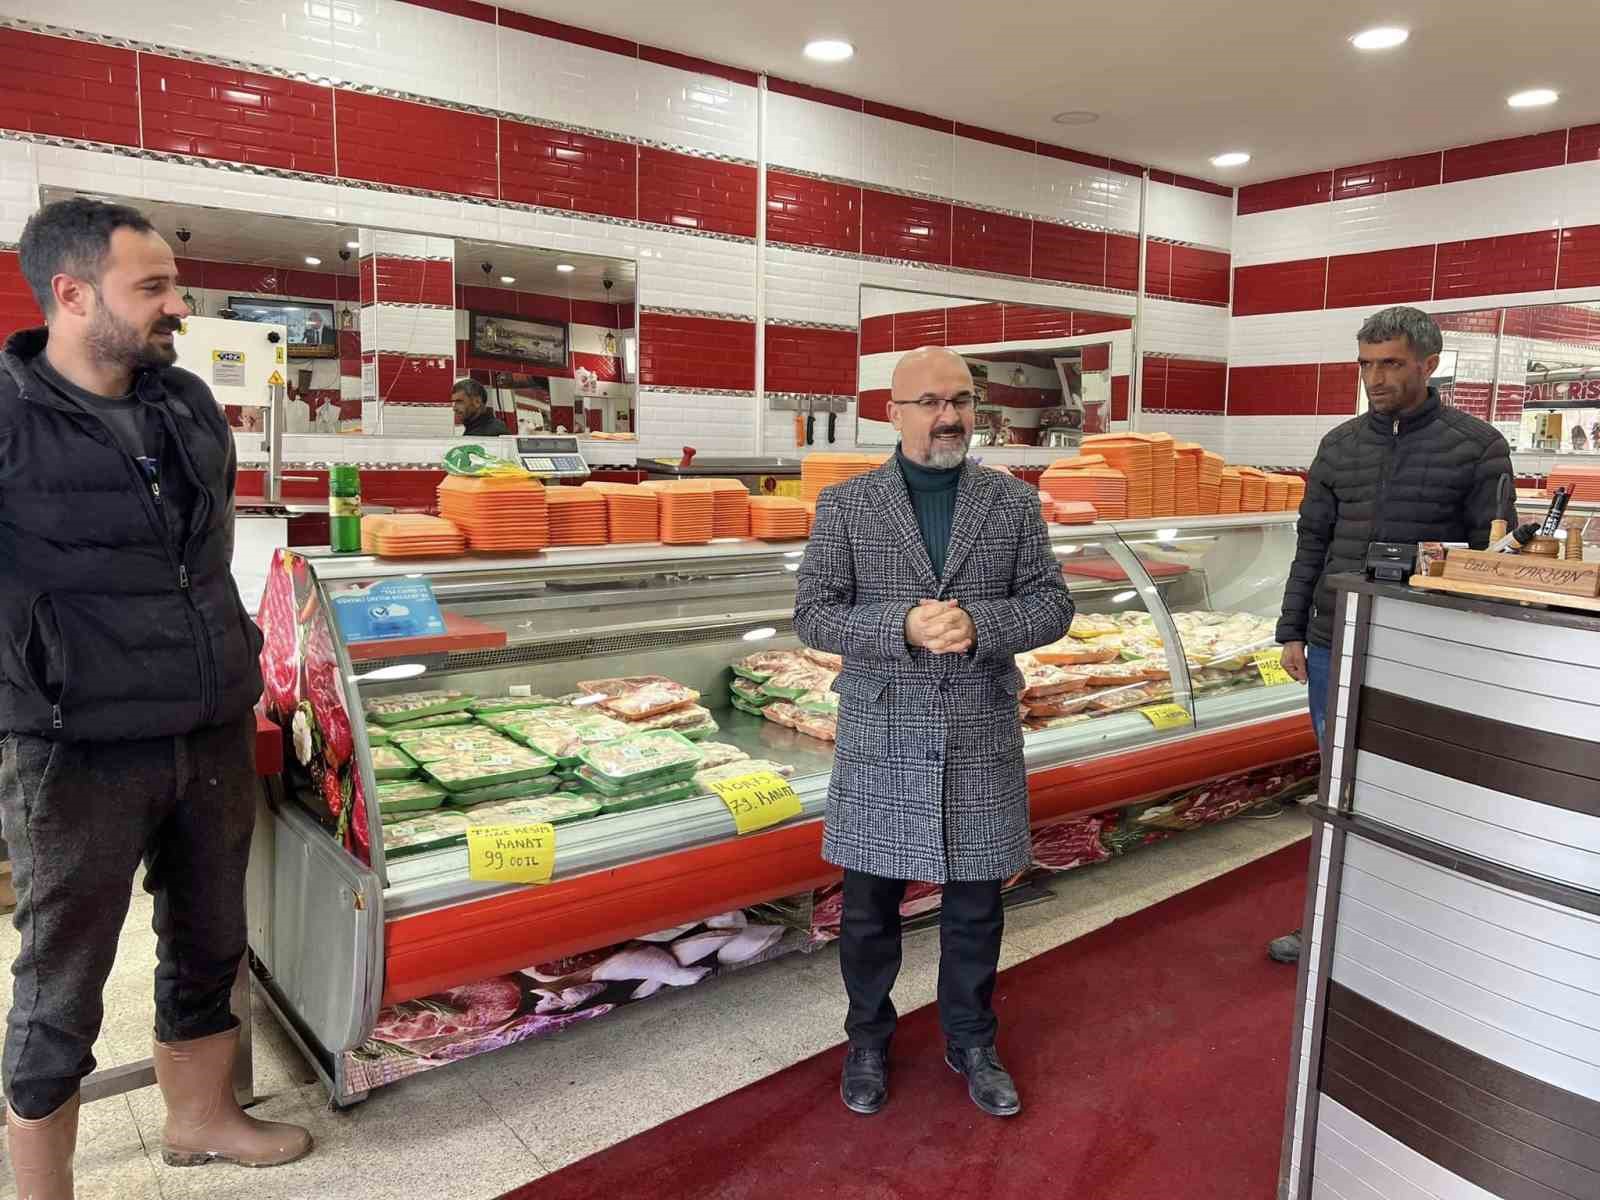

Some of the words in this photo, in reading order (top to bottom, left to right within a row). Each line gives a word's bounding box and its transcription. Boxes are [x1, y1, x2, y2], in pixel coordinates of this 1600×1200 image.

[753, 785, 795, 805] KANAT
[496, 838, 544, 849] KANAT
[484, 850, 504, 871] 99
